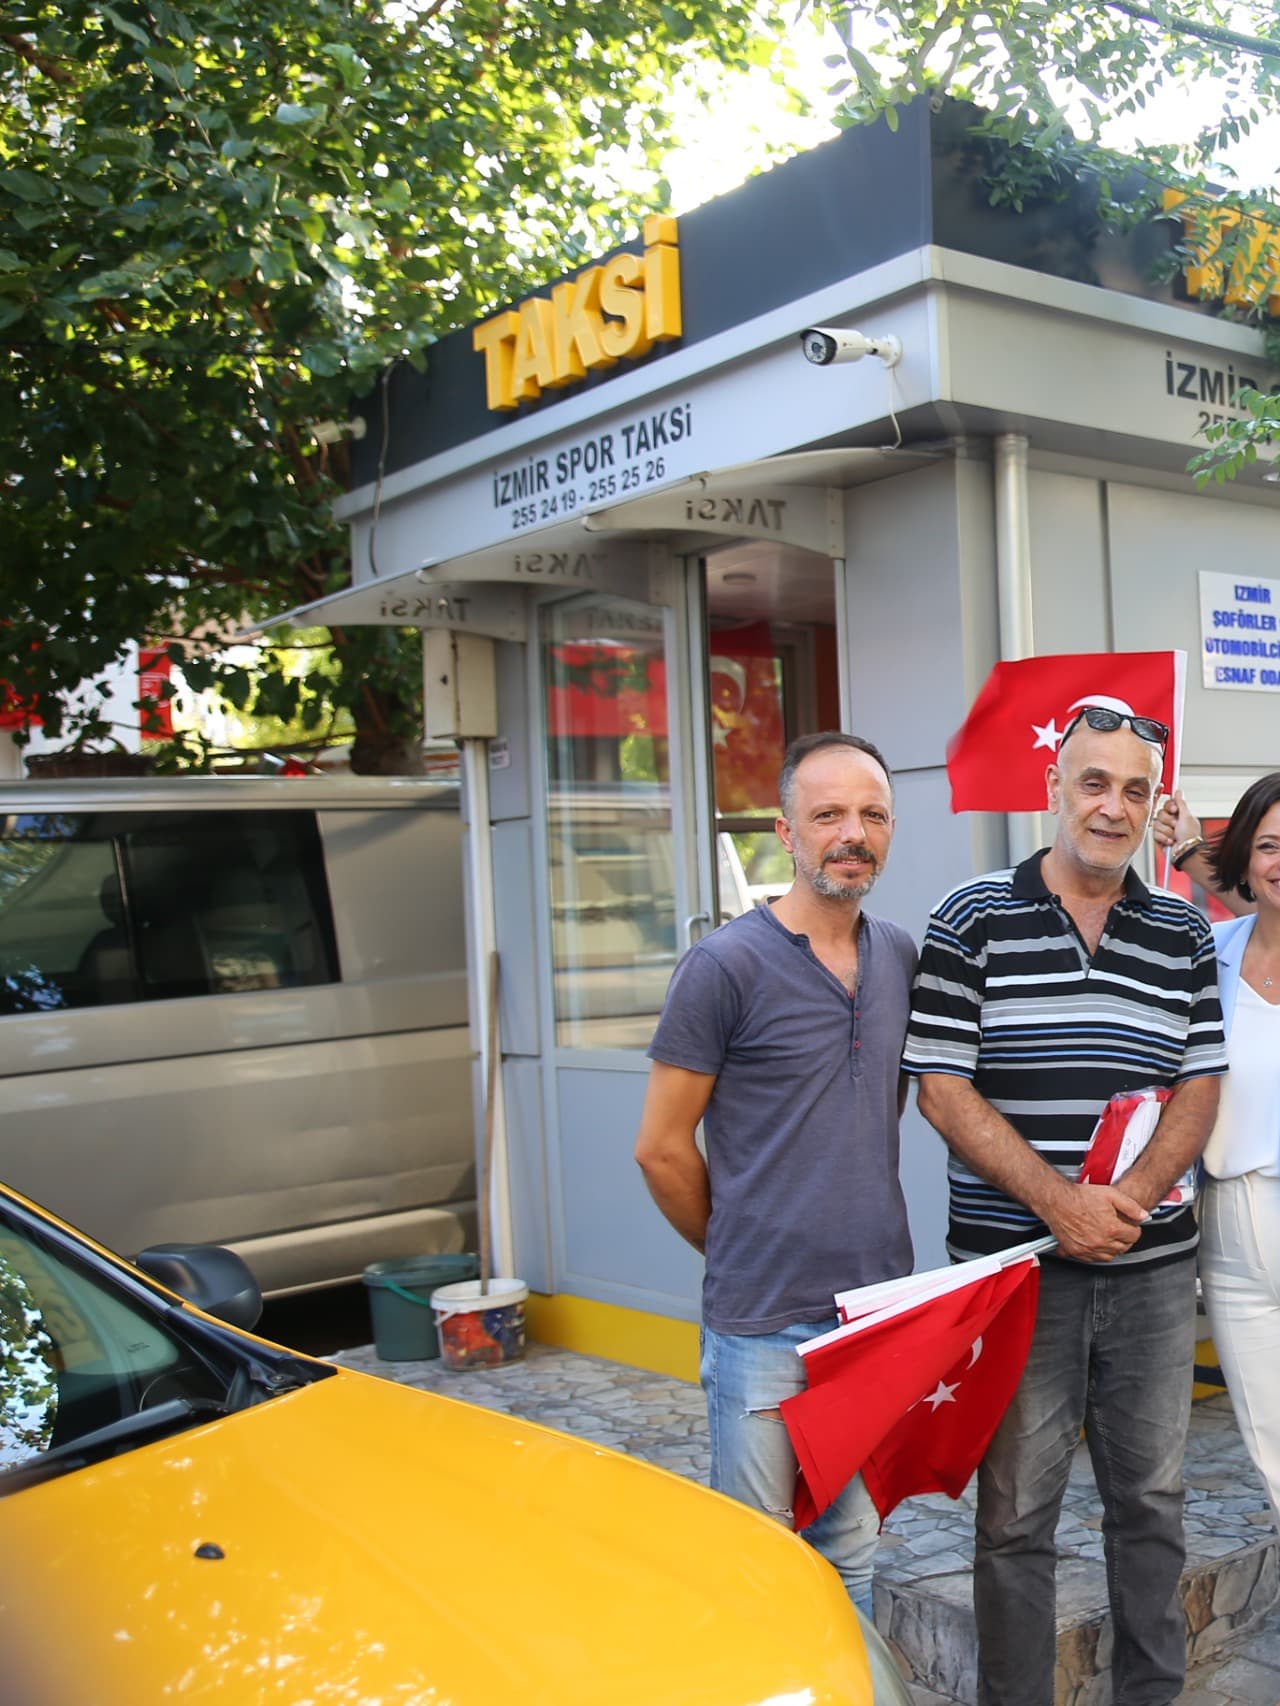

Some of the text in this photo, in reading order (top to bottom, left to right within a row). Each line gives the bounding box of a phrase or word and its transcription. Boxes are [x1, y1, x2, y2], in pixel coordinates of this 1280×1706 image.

[473, 214, 682, 411] TAKSİ
[493, 456, 550, 508] İZMİR
[556, 434, 615, 484] SPOR
[512, 502, 537, 529] 255
[541, 497, 558, 519] 24
[562, 489, 577, 511] 19
[589, 475, 616, 502] 255
[622, 466, 640, 490] 25
[646, 457, 665, 482] 26
[1213, 608, 1276, 632] ŞOFÖRLER
[1215, 666, 1256, 684] ESNAF
